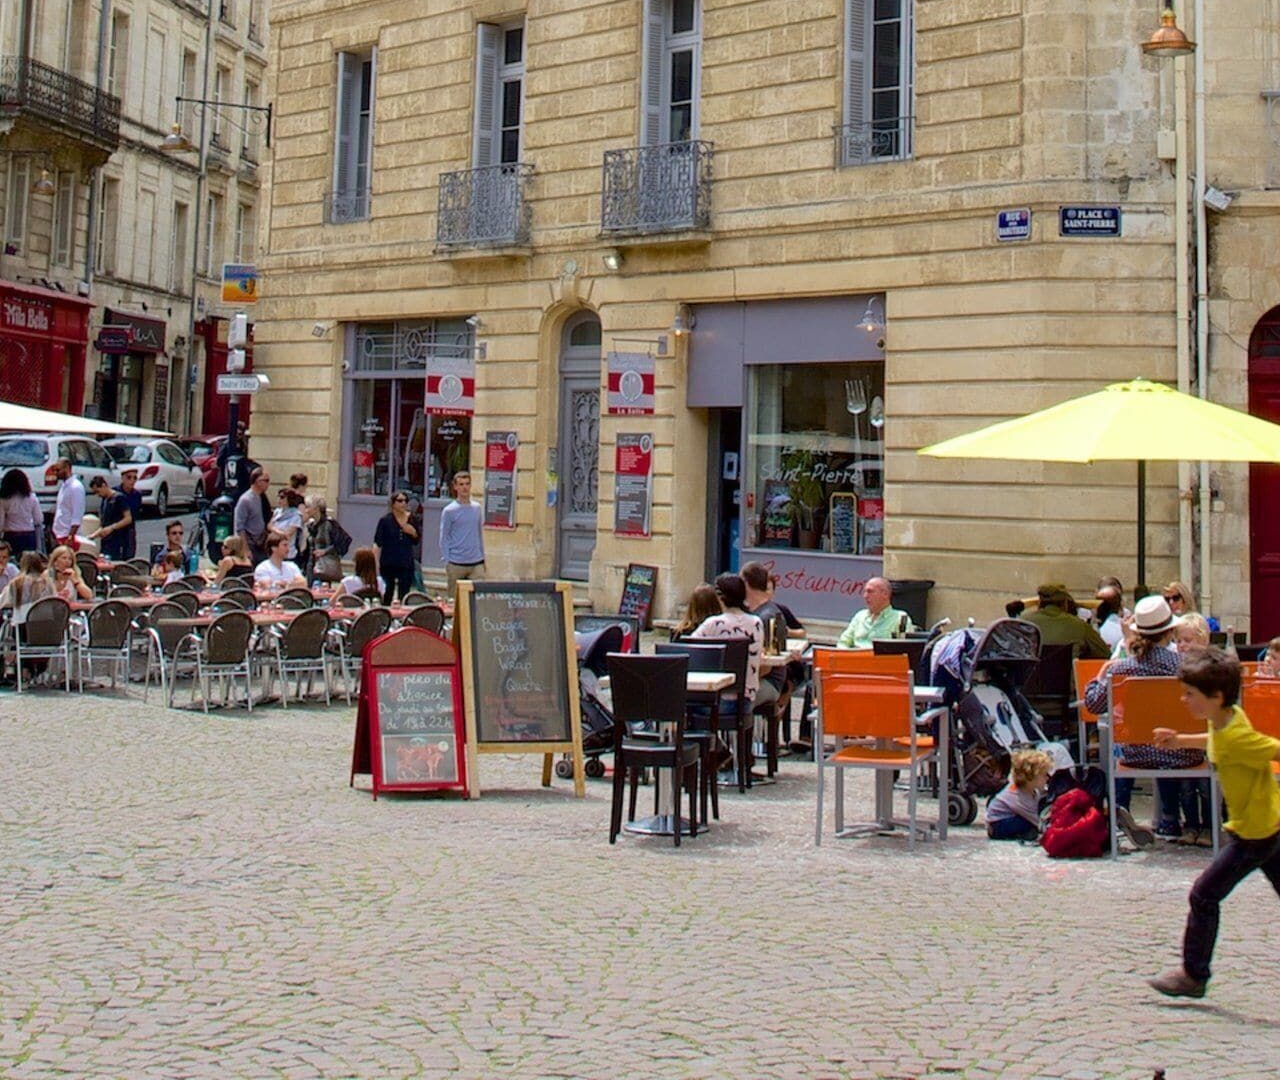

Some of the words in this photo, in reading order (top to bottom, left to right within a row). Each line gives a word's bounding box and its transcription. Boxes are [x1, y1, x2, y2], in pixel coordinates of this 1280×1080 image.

[1006, 210, 1020, 221] RUE
[1077, 210, 1103, 219] PLACE
[1063, 219, 1117, 229] SAINT-PIERRE
[759, 462, 864, 486] Saint-Pierre
[763, 560, 870, 596] estauran
